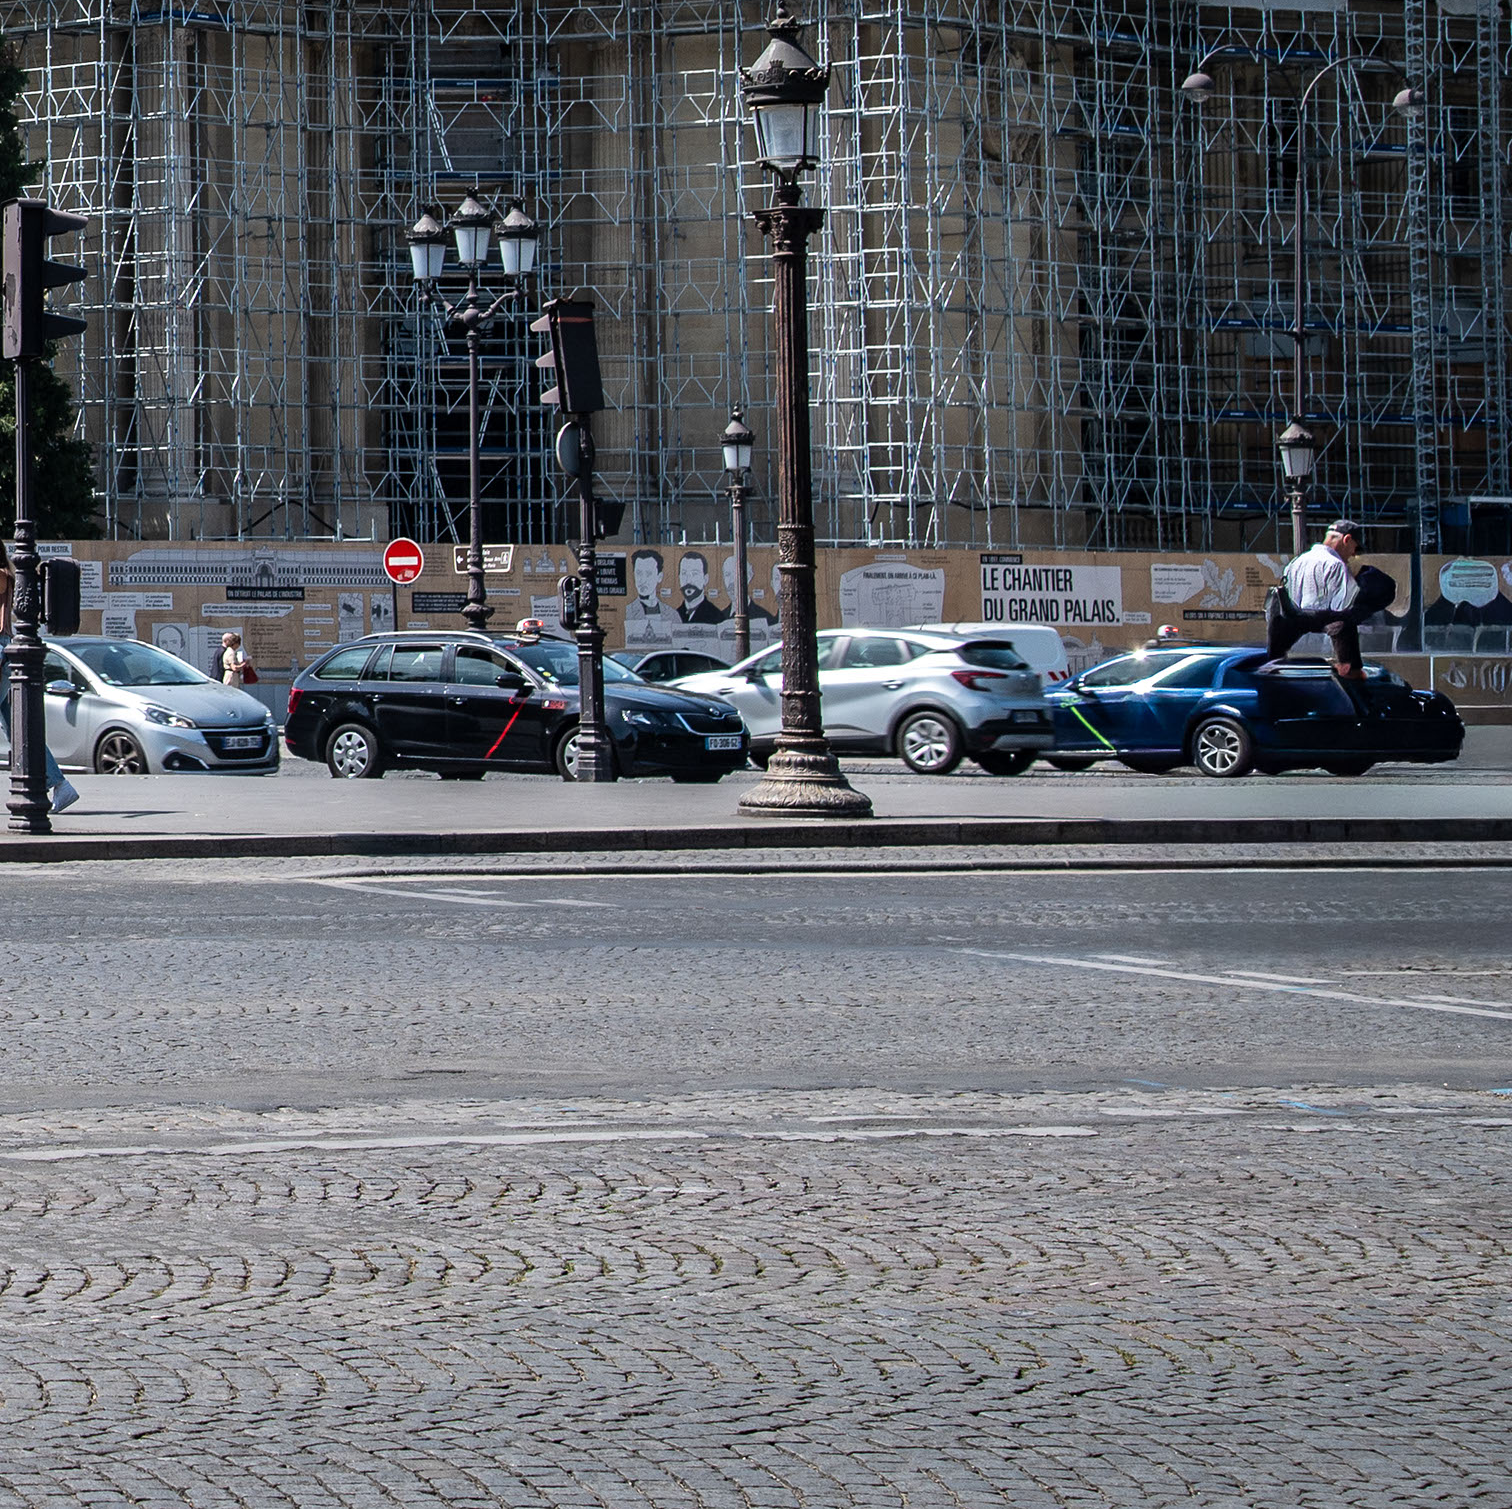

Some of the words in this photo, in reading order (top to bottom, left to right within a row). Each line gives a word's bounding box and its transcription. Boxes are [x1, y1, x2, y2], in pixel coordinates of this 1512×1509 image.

[983, 568, 998, 591] LE
[1003, 568, 1073, 591] CHANTIER
[984, 598, 1003, 621] DU
[1009, 599, 1059, 622] GRAND
[1064, 599, 1120, 622] PALAIS.
